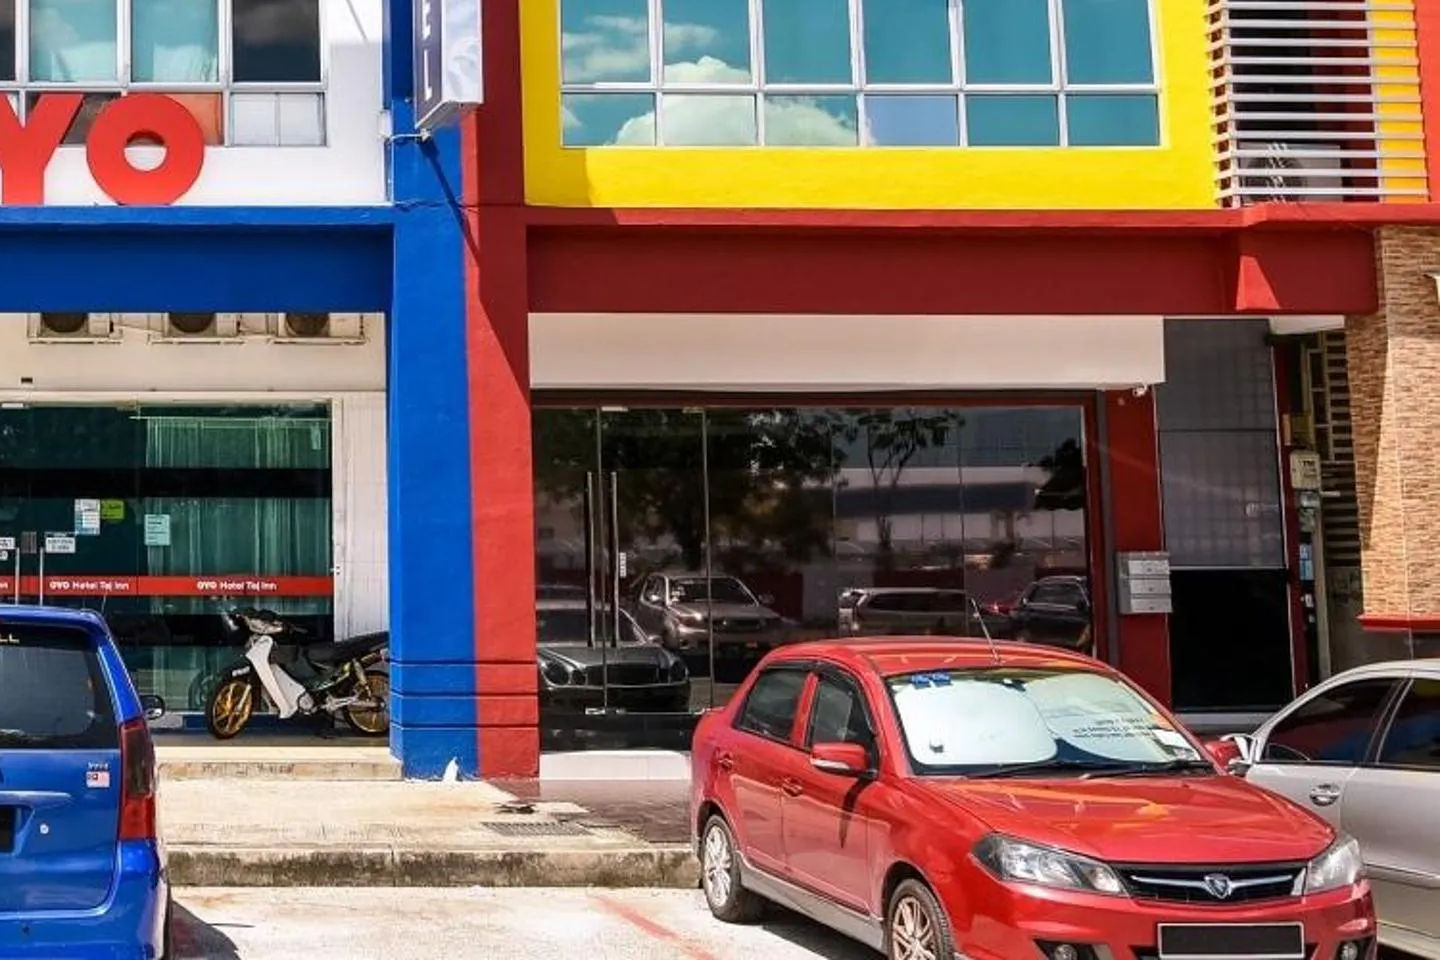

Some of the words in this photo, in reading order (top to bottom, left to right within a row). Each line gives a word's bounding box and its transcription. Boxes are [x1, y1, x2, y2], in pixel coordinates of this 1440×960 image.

[49, 581, 70, 590] OYO
[72, 581, 98, 590] Hotel
[196, 581, 217, 590] OYO
[220, 581, 244, 590] Hotel
